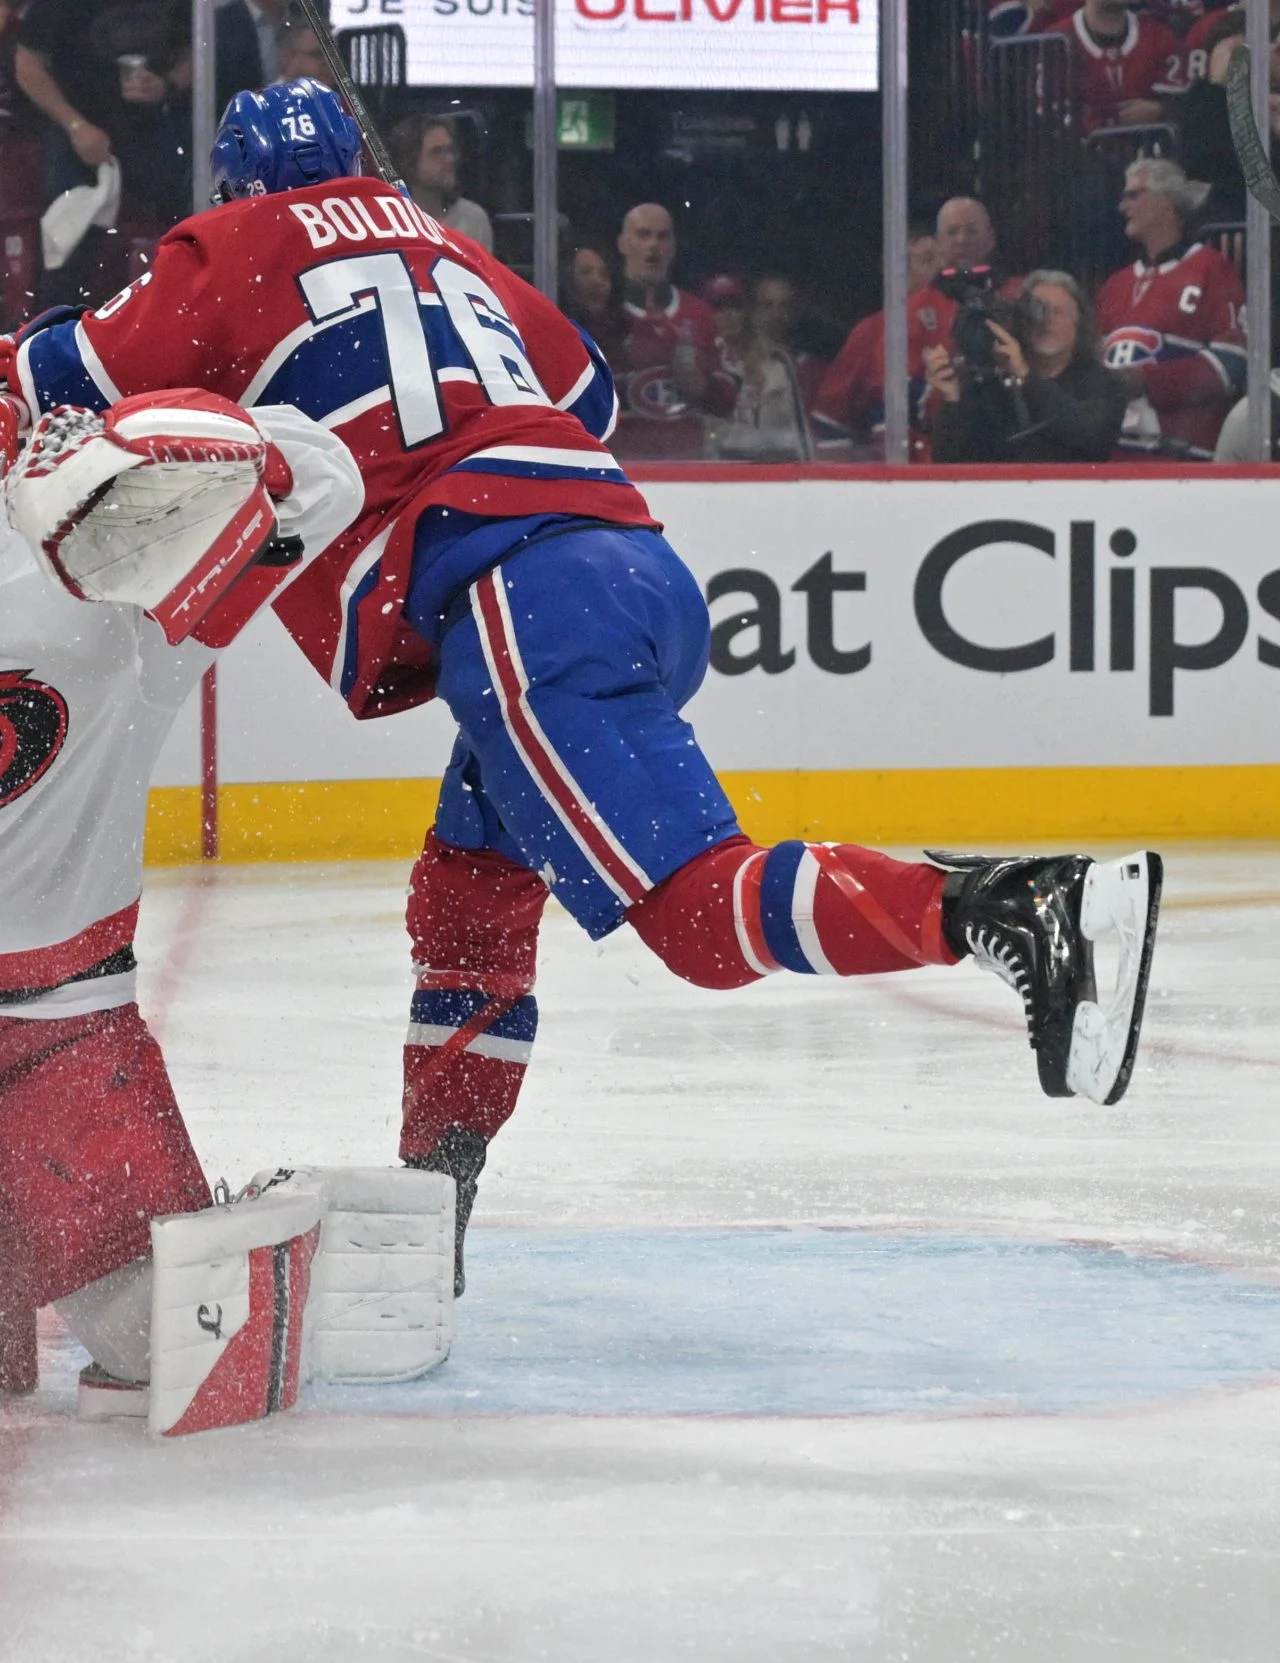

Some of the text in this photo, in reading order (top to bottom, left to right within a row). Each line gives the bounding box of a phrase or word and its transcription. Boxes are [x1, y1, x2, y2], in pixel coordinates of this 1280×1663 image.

[281, 114, 316, 141] 76
[1178, 285, 1202, 314] C
[293, 249, 557, 453] 76
